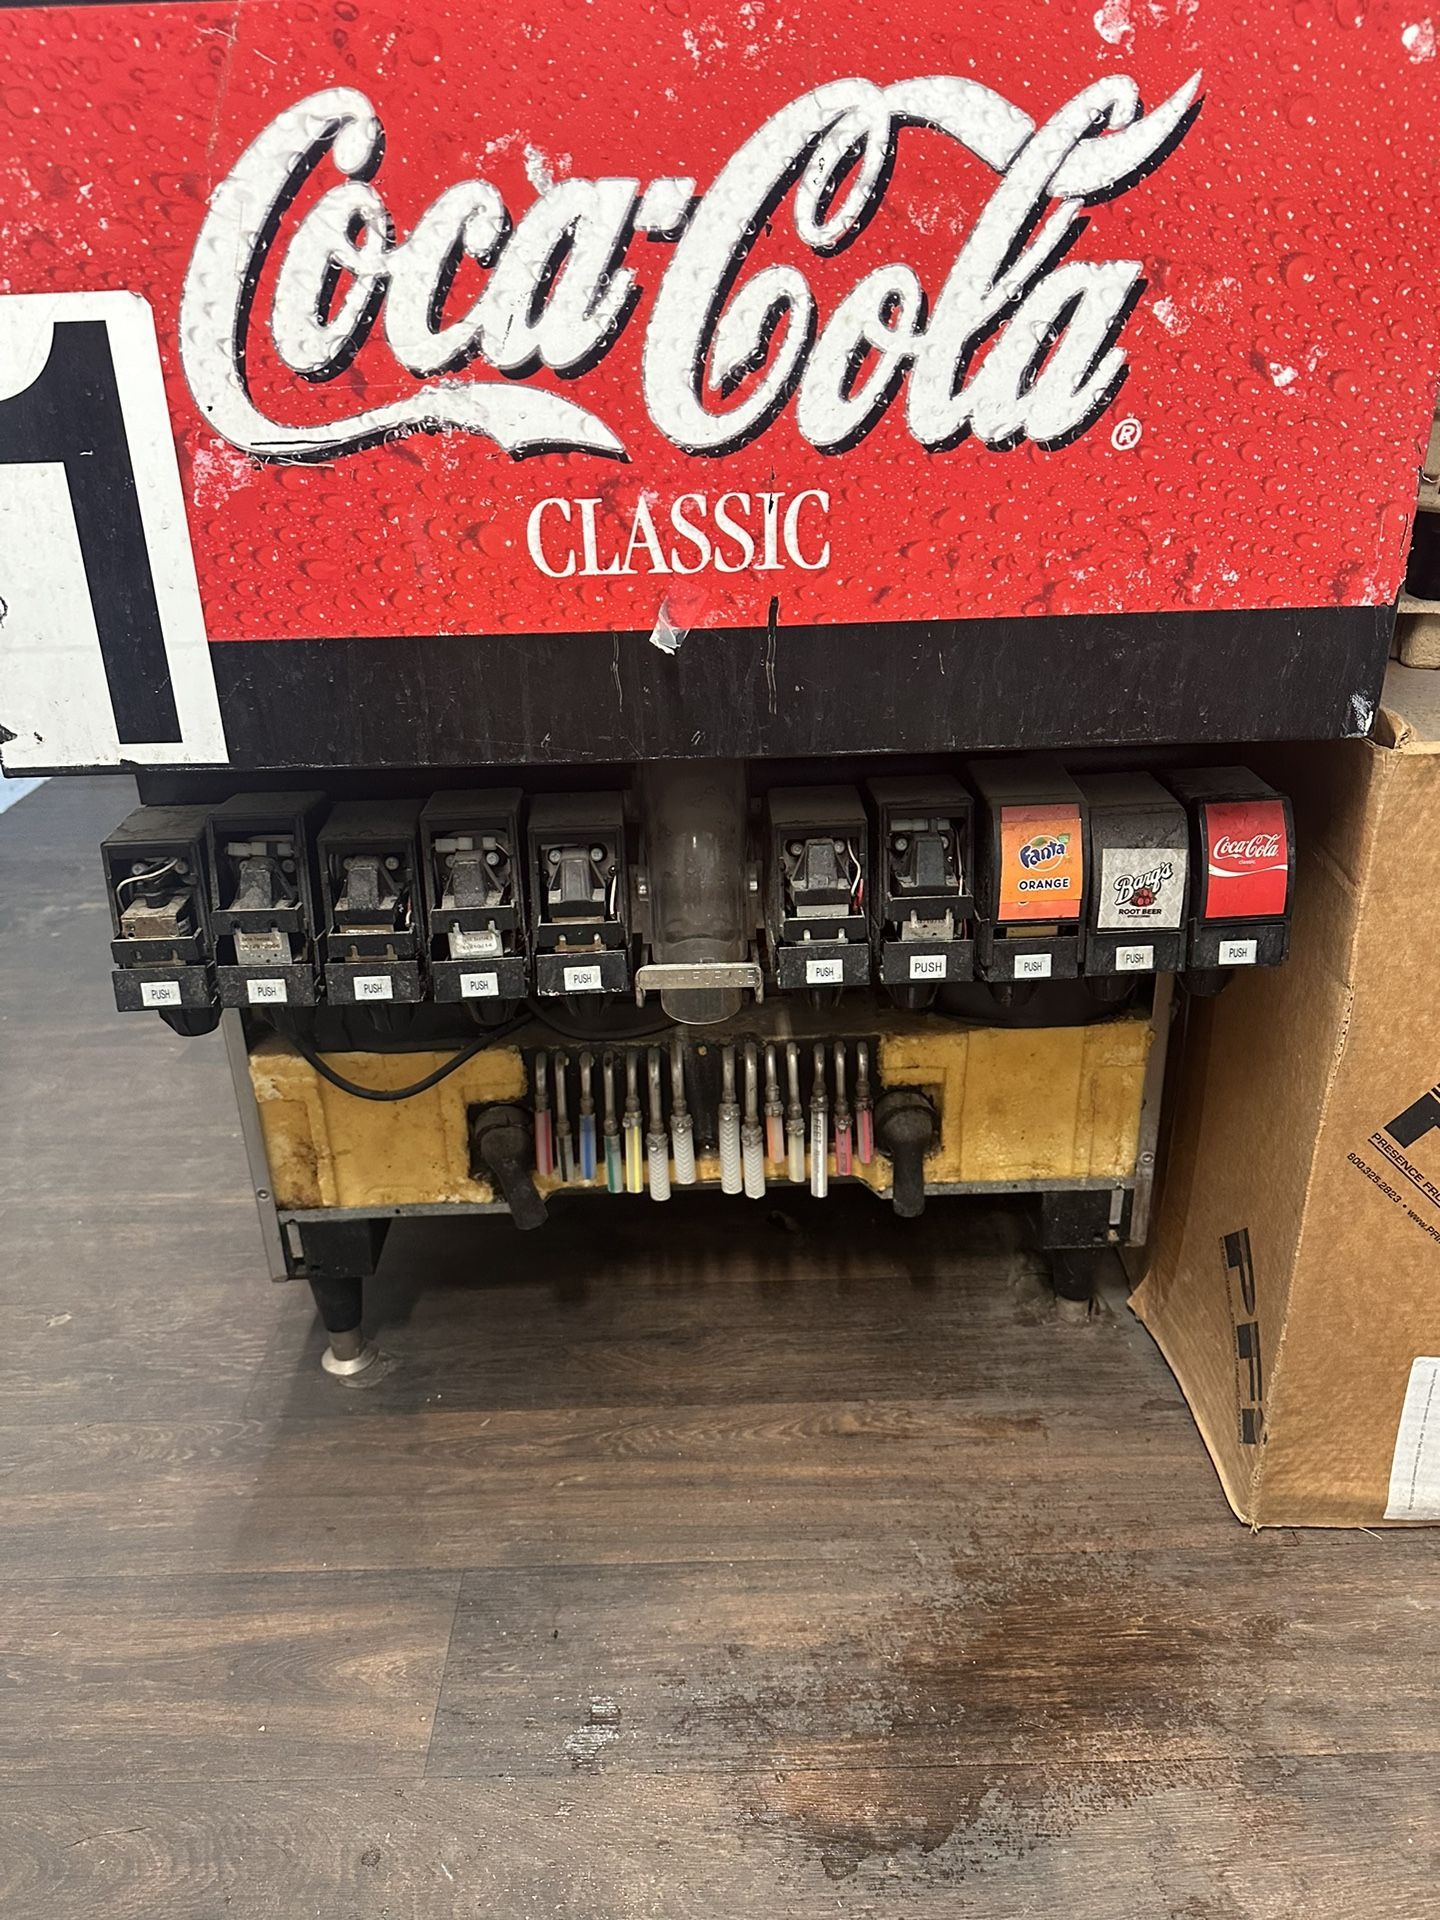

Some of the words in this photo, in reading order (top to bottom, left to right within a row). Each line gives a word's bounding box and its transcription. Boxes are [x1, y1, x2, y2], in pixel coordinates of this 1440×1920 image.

[178, 68, 1205, 465] Coca-Cola
[527, 489, 831, 578] CLASSIC
[1213, 833, 1282, 860] Coca-Cola
[1019, 841, 1066, 869] Fanta
[1019, 878, 1070, 891] ORANGE
[1113, 862, 1174, 906] Barq's
[1228, 947, 1247, 958] PUSH
[1125, 953, 1144, 964] PUSH
[815, 966, 834, 977] PUSH
[914, 962, 942, 973] PUSH
[1023, 961, 1042, 972] PUSH
[573, 973, 592, 984] PUSH
[364, 983, 383, 993] PUSH
[470, 980, 489, 991] PUSH
[151, 989, 171, 1000] PUSH
[257, 987, 277, 997] PUSH
[1371, 1132, 1425, 1182] PRESENCE
[1347, 1152, 1402, 1203] 800.325.2823
